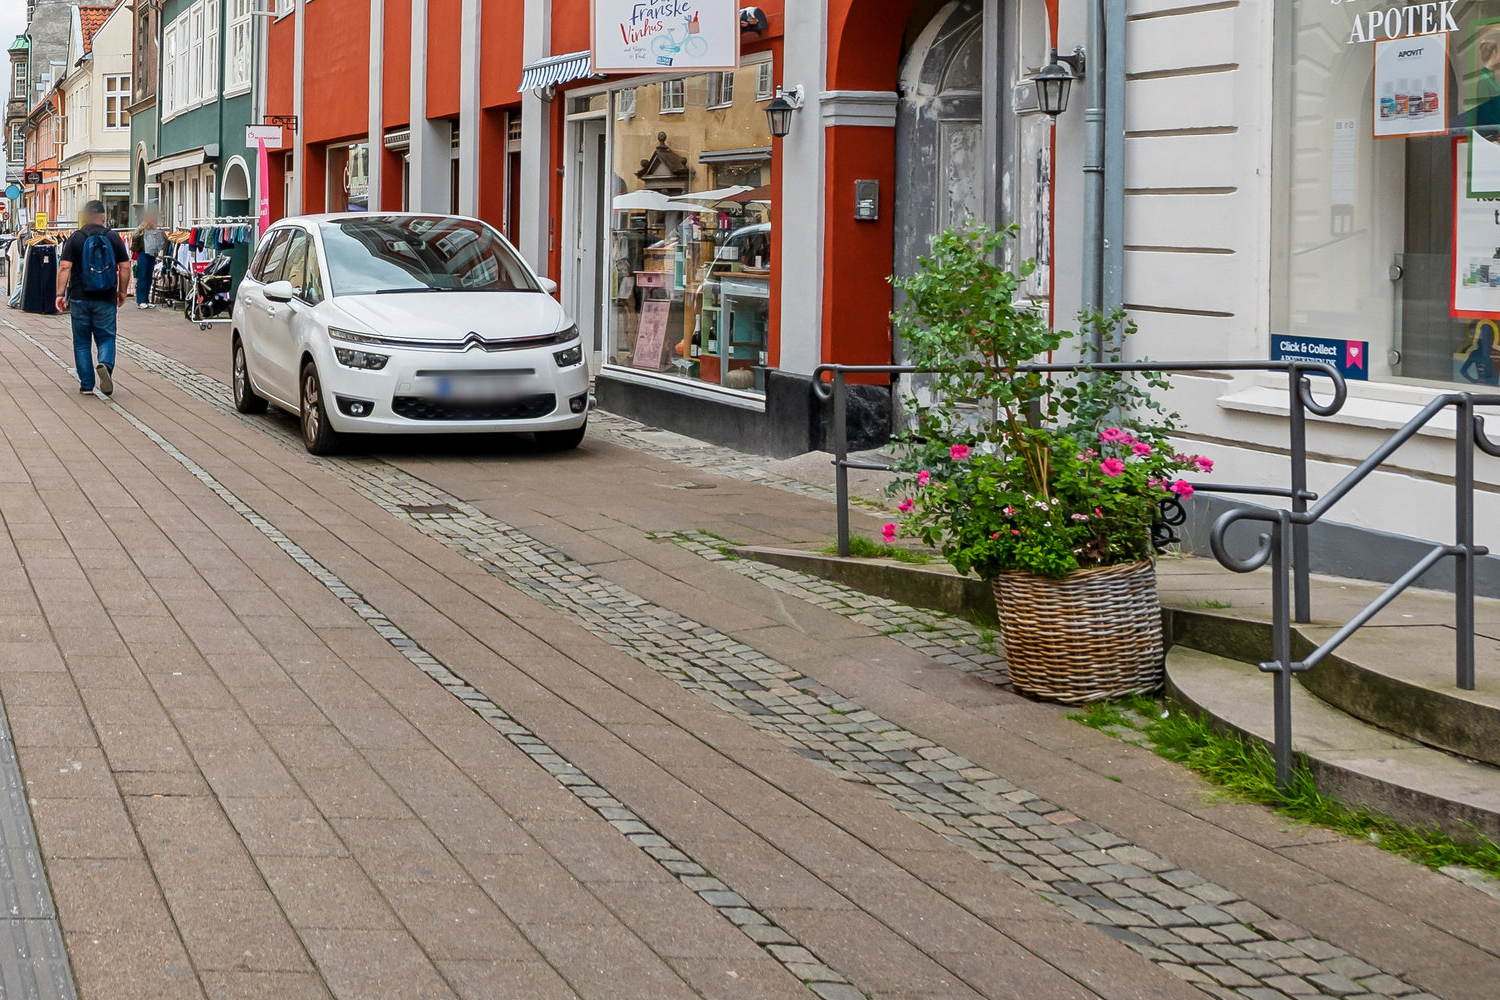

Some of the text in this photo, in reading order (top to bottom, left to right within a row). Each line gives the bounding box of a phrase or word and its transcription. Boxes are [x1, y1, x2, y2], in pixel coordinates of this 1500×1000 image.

[620, 18, 663, 46] Vinhus
[1347, 0, 1460, 44] APOTEK
[1398, 48, 1424, 58] APOVIT
[1280, 341, 1337, 356] Click & Collect
